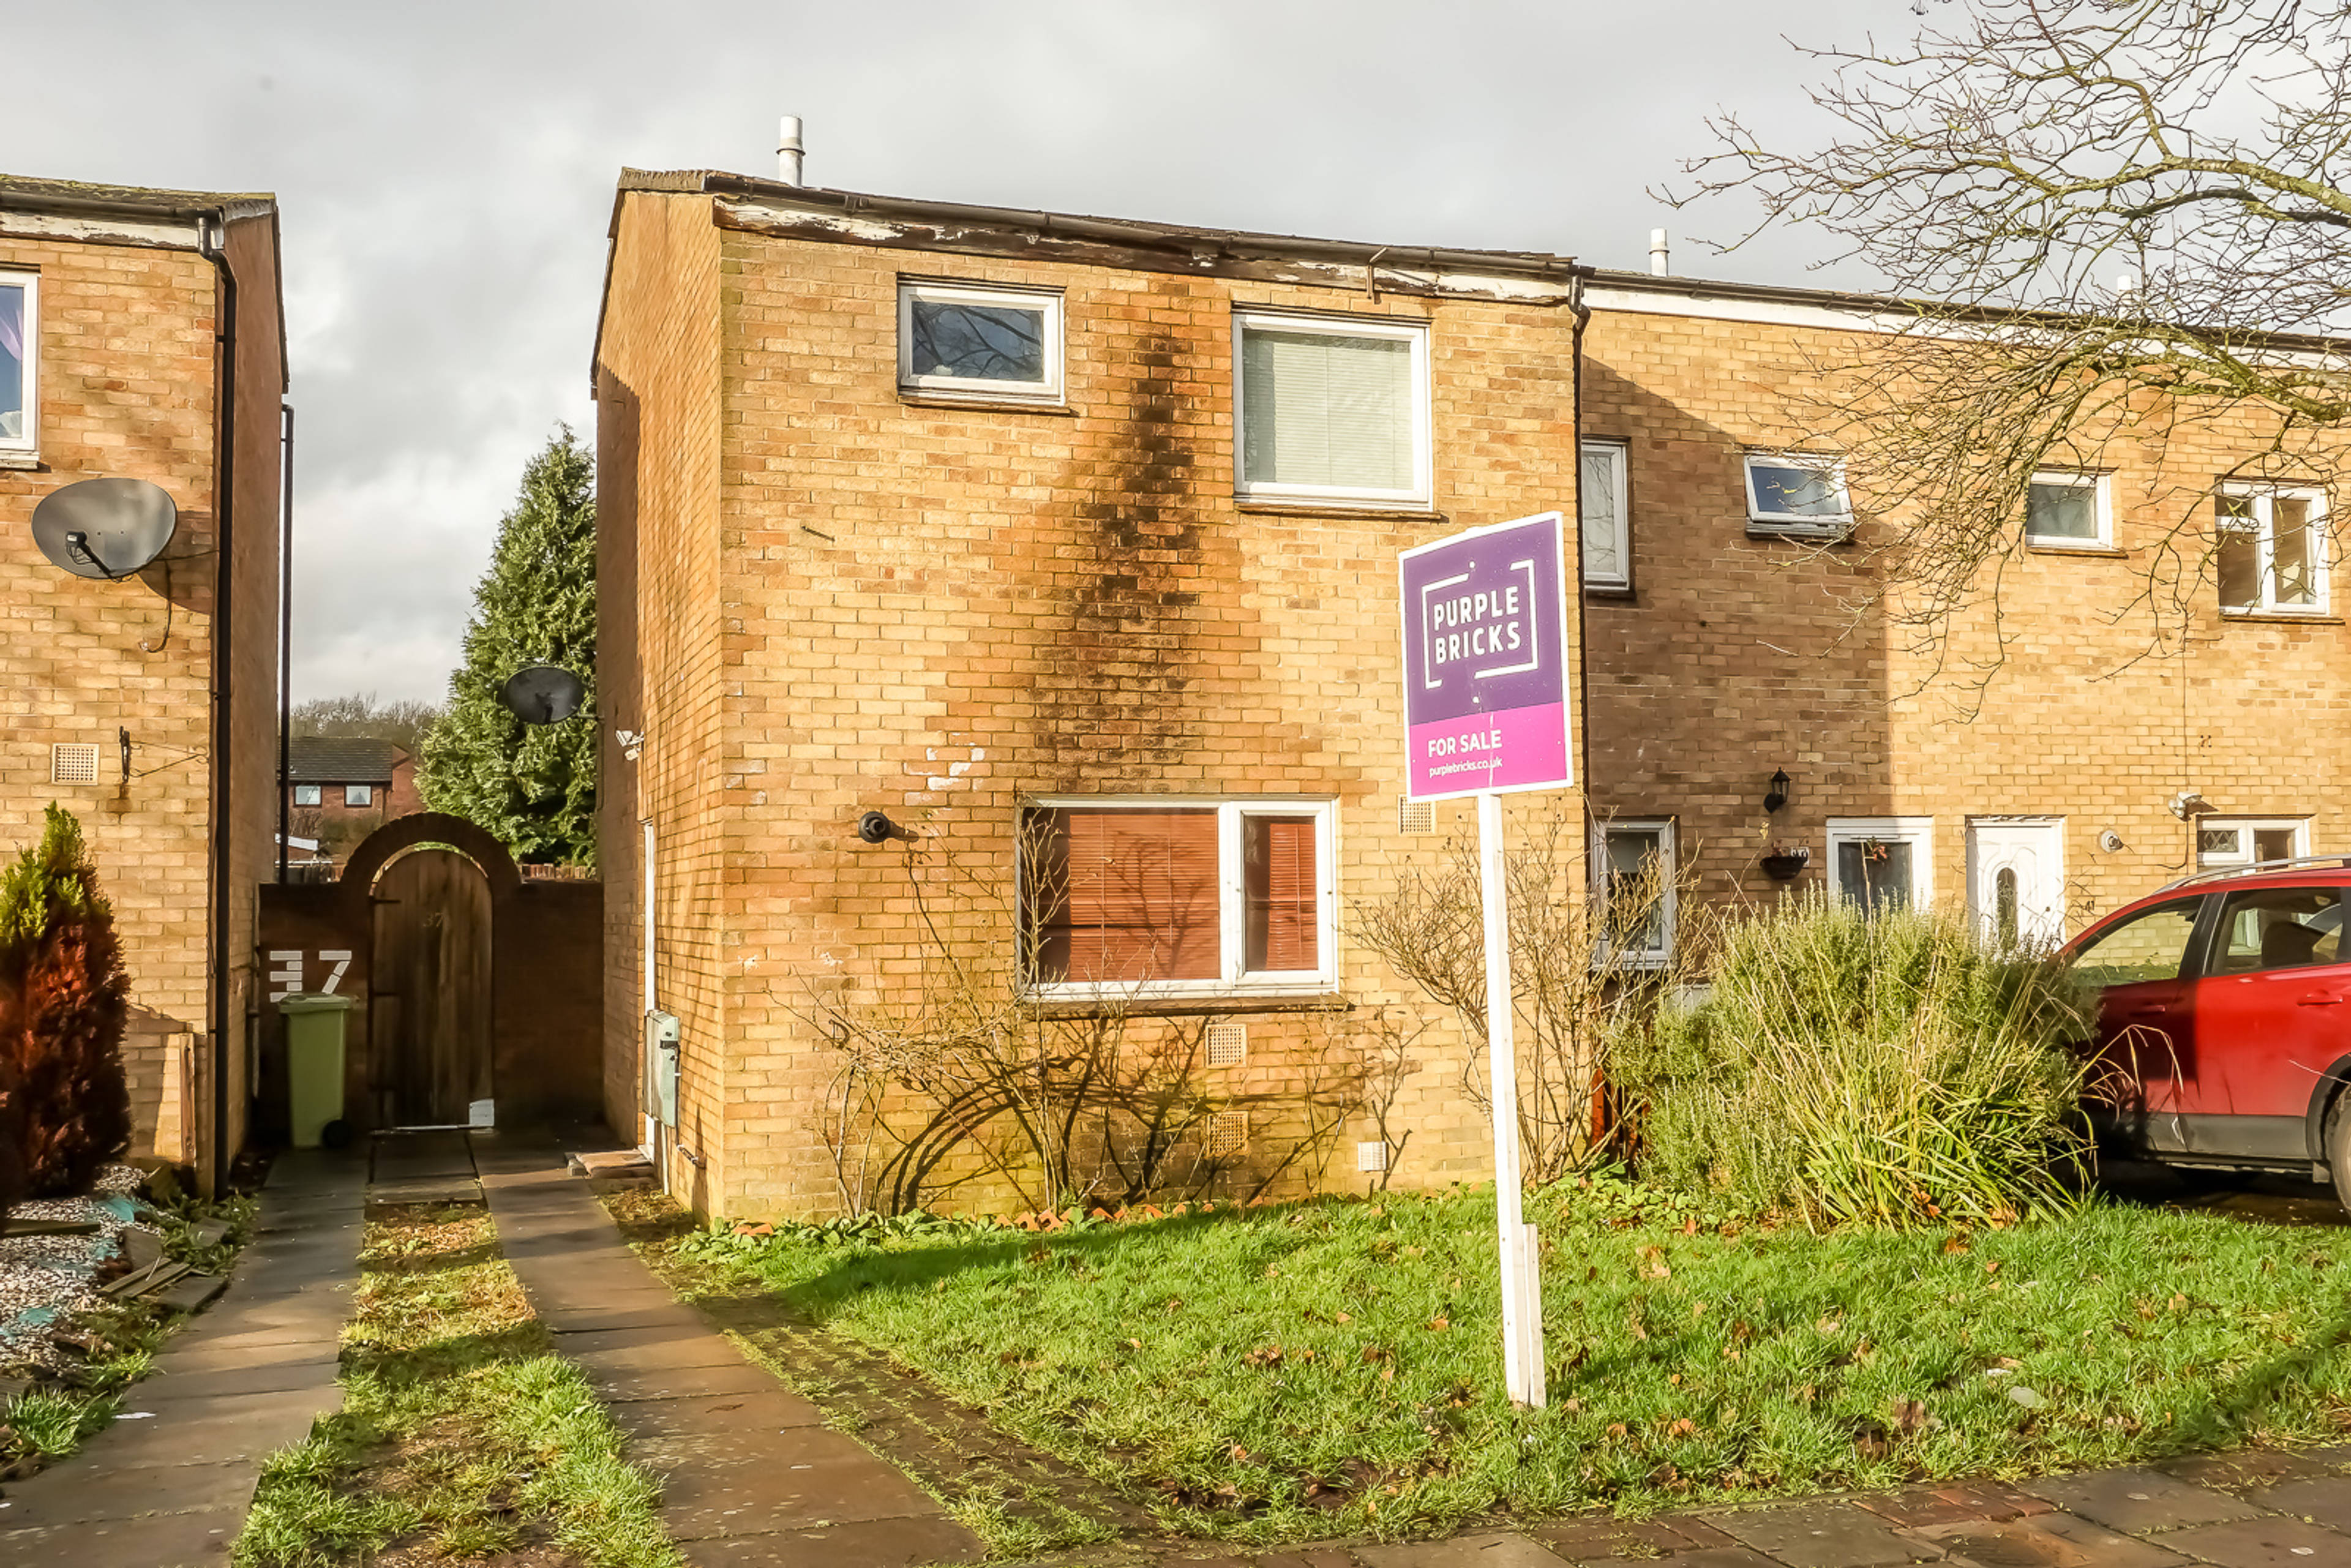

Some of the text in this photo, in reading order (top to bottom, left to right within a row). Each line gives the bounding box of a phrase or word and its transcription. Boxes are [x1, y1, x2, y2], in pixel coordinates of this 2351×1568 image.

[1434, 586, 1519, 631] PURPLE
[1435, 621, 1521, 665] BRICKS
[1428, 729, 1502, 758] FOR SALE
[1429, 756, 1503, 779] purplebricks.co.uk
[269, 950, 352, 1003] 37
